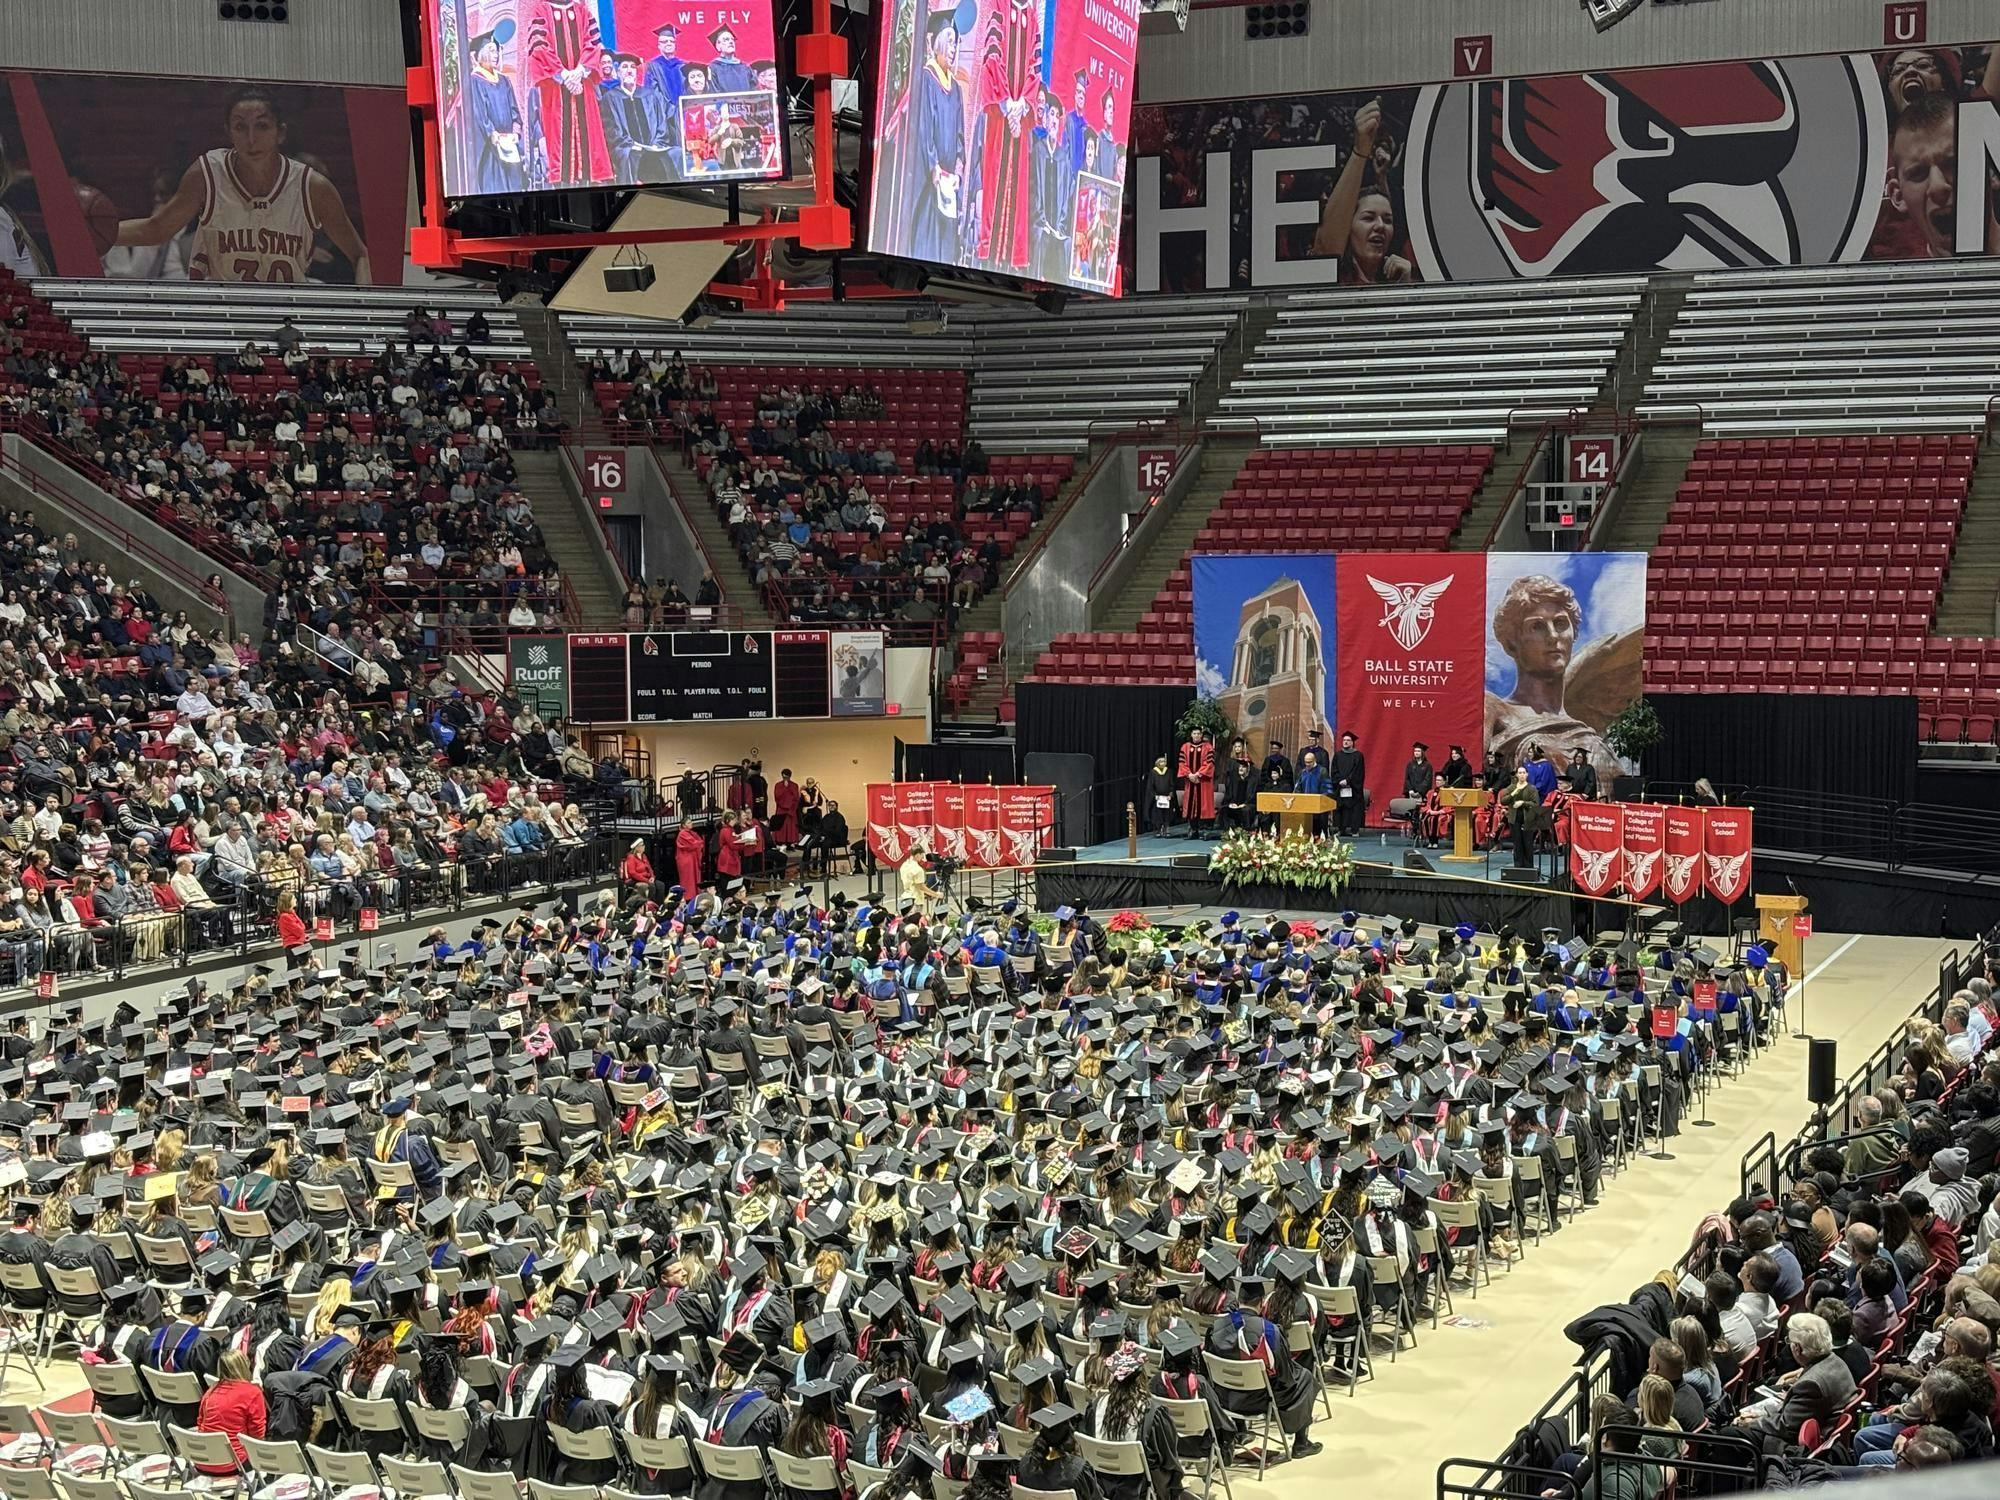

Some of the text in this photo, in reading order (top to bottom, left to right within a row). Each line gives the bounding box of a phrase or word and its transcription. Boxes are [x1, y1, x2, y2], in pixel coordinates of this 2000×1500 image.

[678, 10, 751, 24] WE FLY
[1085, 0, 1136, 48] UNIVERSITY
[1895, 14, 1915, 40] U
[1463, 47, 1483, 71] V
[1089, 56, 1125, 91] WE FLY
[1136, 144, 1338, 292] HE
[218, 227, 303, 257] BALL STATE
[1574, 452, 1609, 478] 14
[587, 462, 621, 488] 16
[1140, 462, 1170, 487] 15
[1365, 660, 1453, 672] BALL STATE
[515, 666, 562, 680] Ruoff
[1370, 675, 1448, 685] UNIVERSITY
[1383, 699, 1435, 708] WE FLY
[945, 796, 963, 804] Colleg
[1624, 809, 1639, 817] Wayne
[1594, 816, 1615, 825] College
[1628, 817, 1647, 825] College
[1669, 819, 1689, 827] Honors
[1588, 823, 1613, 832] Business
[1625, 825, 1655, 833] Architecture
[1669, 827, 1689, 836] College
[1715, 828, 1735, 836] School
[1635, 834, 1656, 843] Planning
